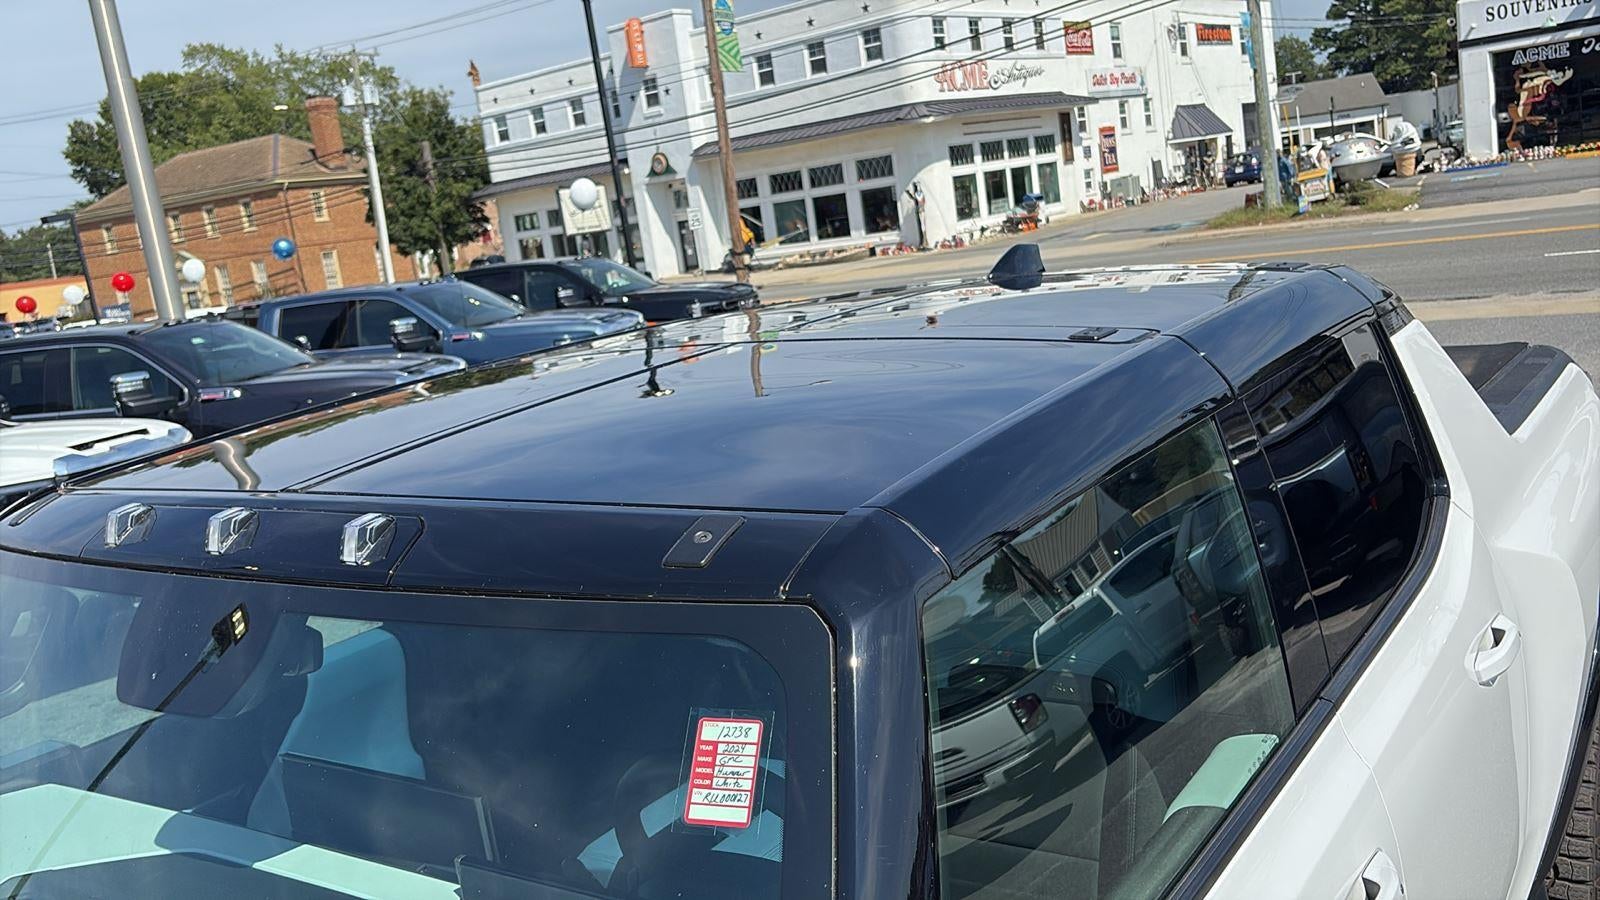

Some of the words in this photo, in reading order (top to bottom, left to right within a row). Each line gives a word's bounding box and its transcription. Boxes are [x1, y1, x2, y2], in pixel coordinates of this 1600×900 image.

[1486, 0, 1592, 22] SOUVENI
[1512, 42, 1570, 65] ACME
[934, 60, 990, 92] ACME
[718, 726, 752, 740] 12738
[723, 743, 747, 753] 2024
